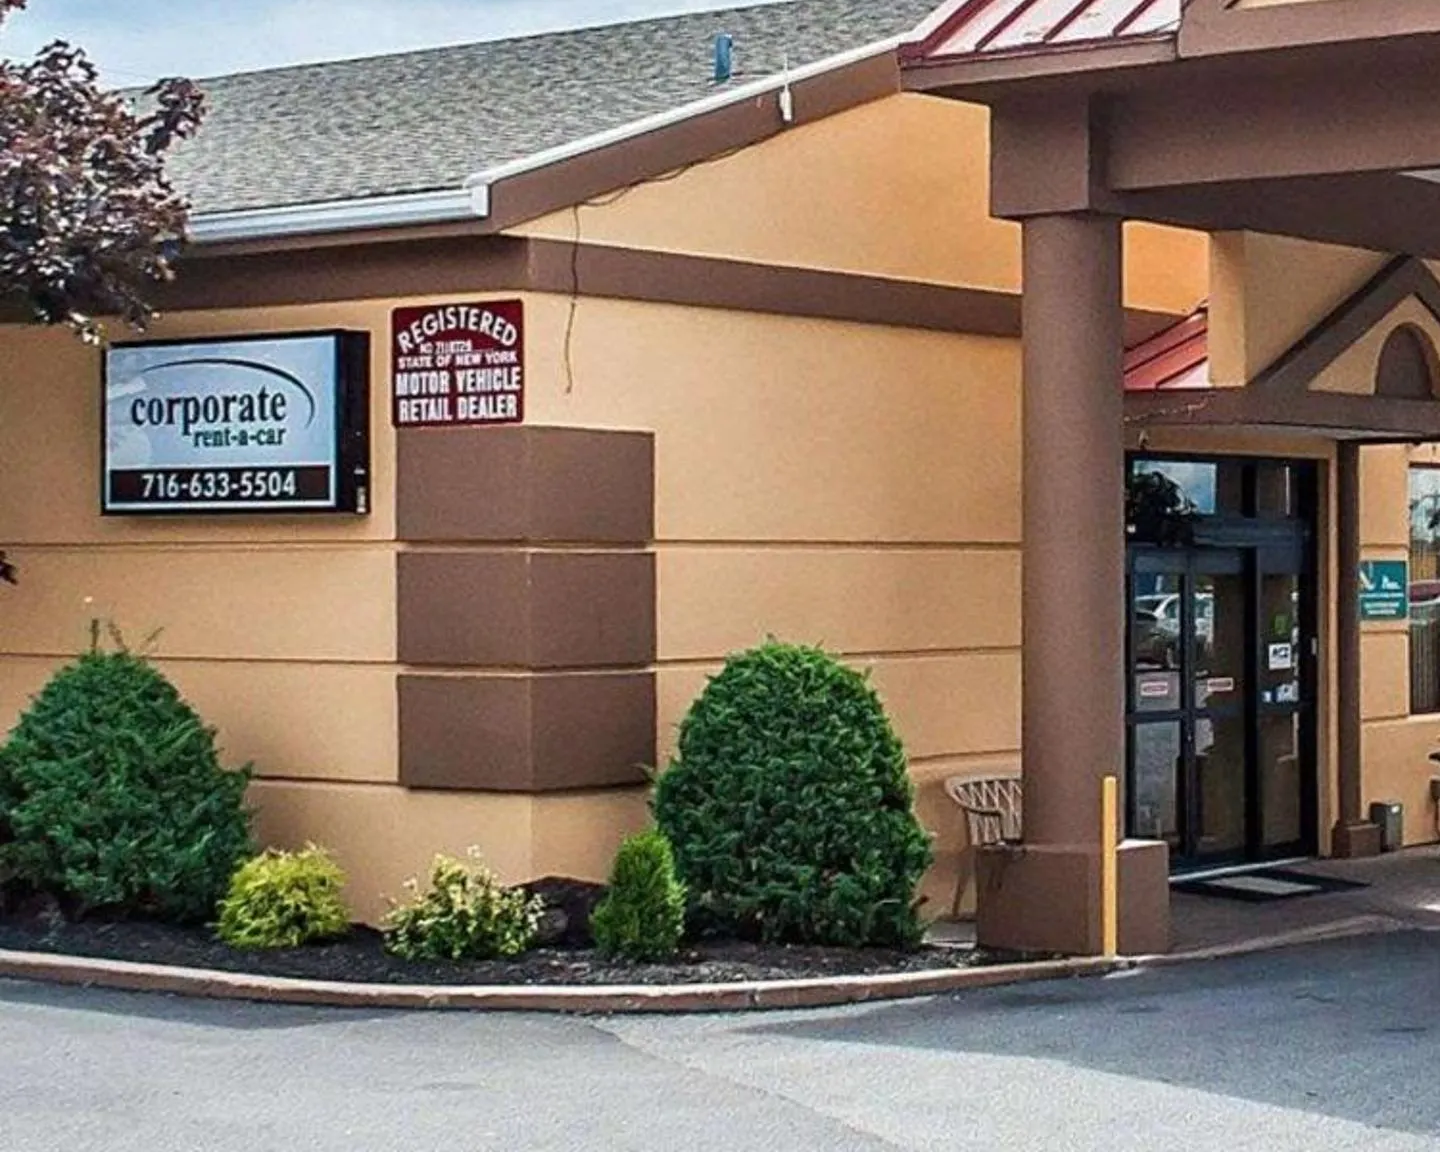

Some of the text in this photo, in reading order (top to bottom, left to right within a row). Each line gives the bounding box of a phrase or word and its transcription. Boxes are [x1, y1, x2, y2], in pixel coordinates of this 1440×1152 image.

[397, 307, 518, 353] REGISTERED
[398, 350, 517, 369] STATE OF NEW YORK
[396, 367, 521, 396] MOTOR VEHICLE
[131, 384, 287, 436] corporate
[399, 394, 517, 422] RETAIL DEALER
[193, 427, 287, 448] rent-a-car
[141, 470, 297, 498] 716-633-5504
